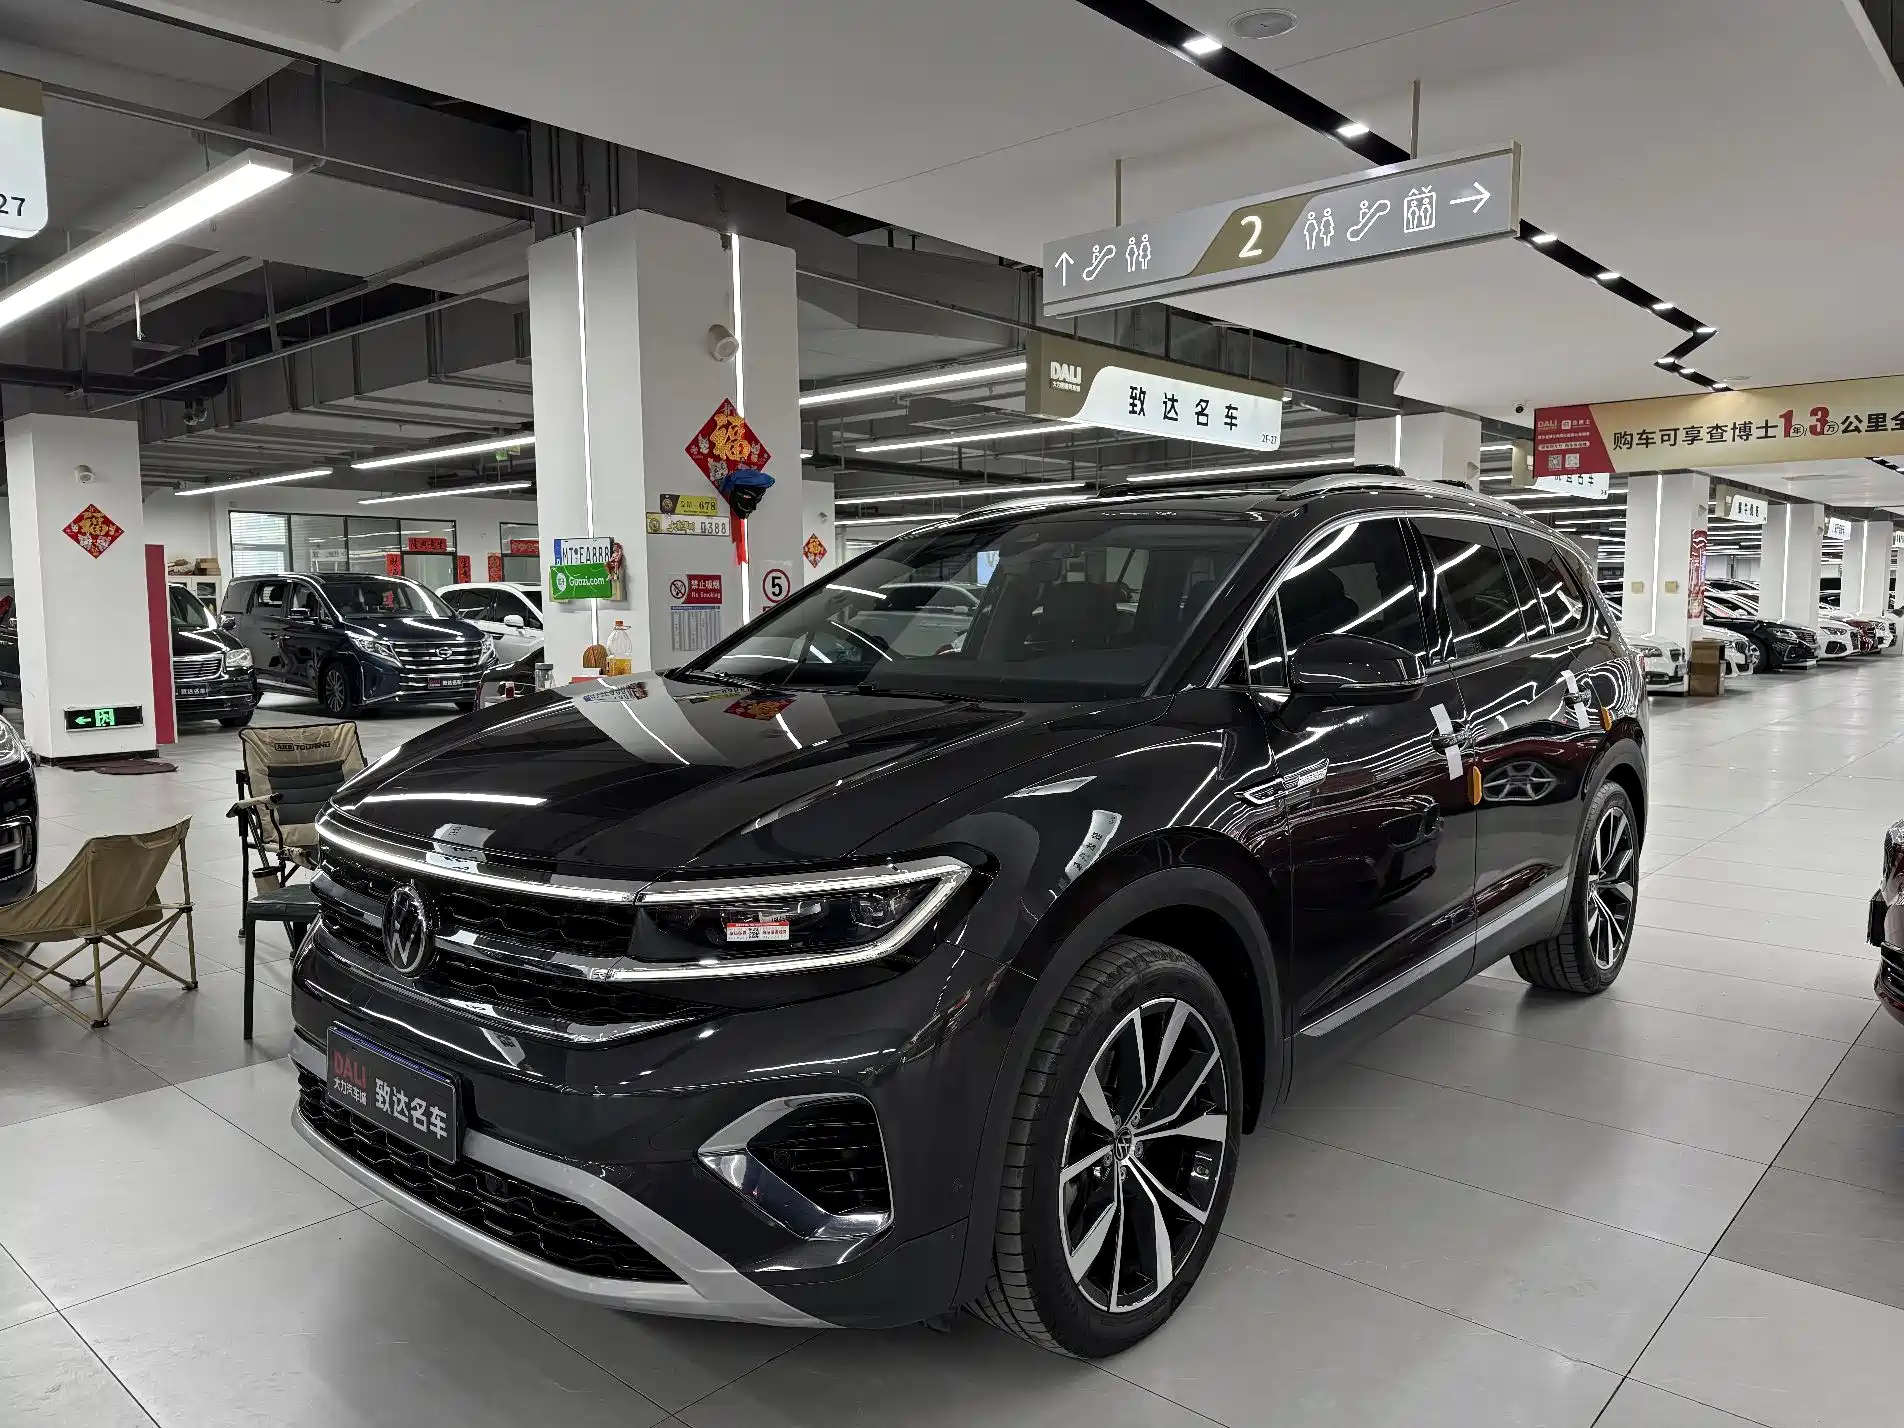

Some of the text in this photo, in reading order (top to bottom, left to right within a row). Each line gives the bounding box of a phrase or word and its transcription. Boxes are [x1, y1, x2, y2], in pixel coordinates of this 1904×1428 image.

[1238, 215, 1263, 258] 2
[1050, 361, 1082, 384] DALI
[1128, 385, 1239, 431] 致达名车
[568, 576, 605, 587] Guazi.com
[691, 579, 720, 590] 禁止吸烟
[771, 575, 783, 597] 5
[700, 591, 721, 599] Smoking
[332, 1050, 368, 1089] DALI
[375, 1077, 448, 1140] 致达名车
